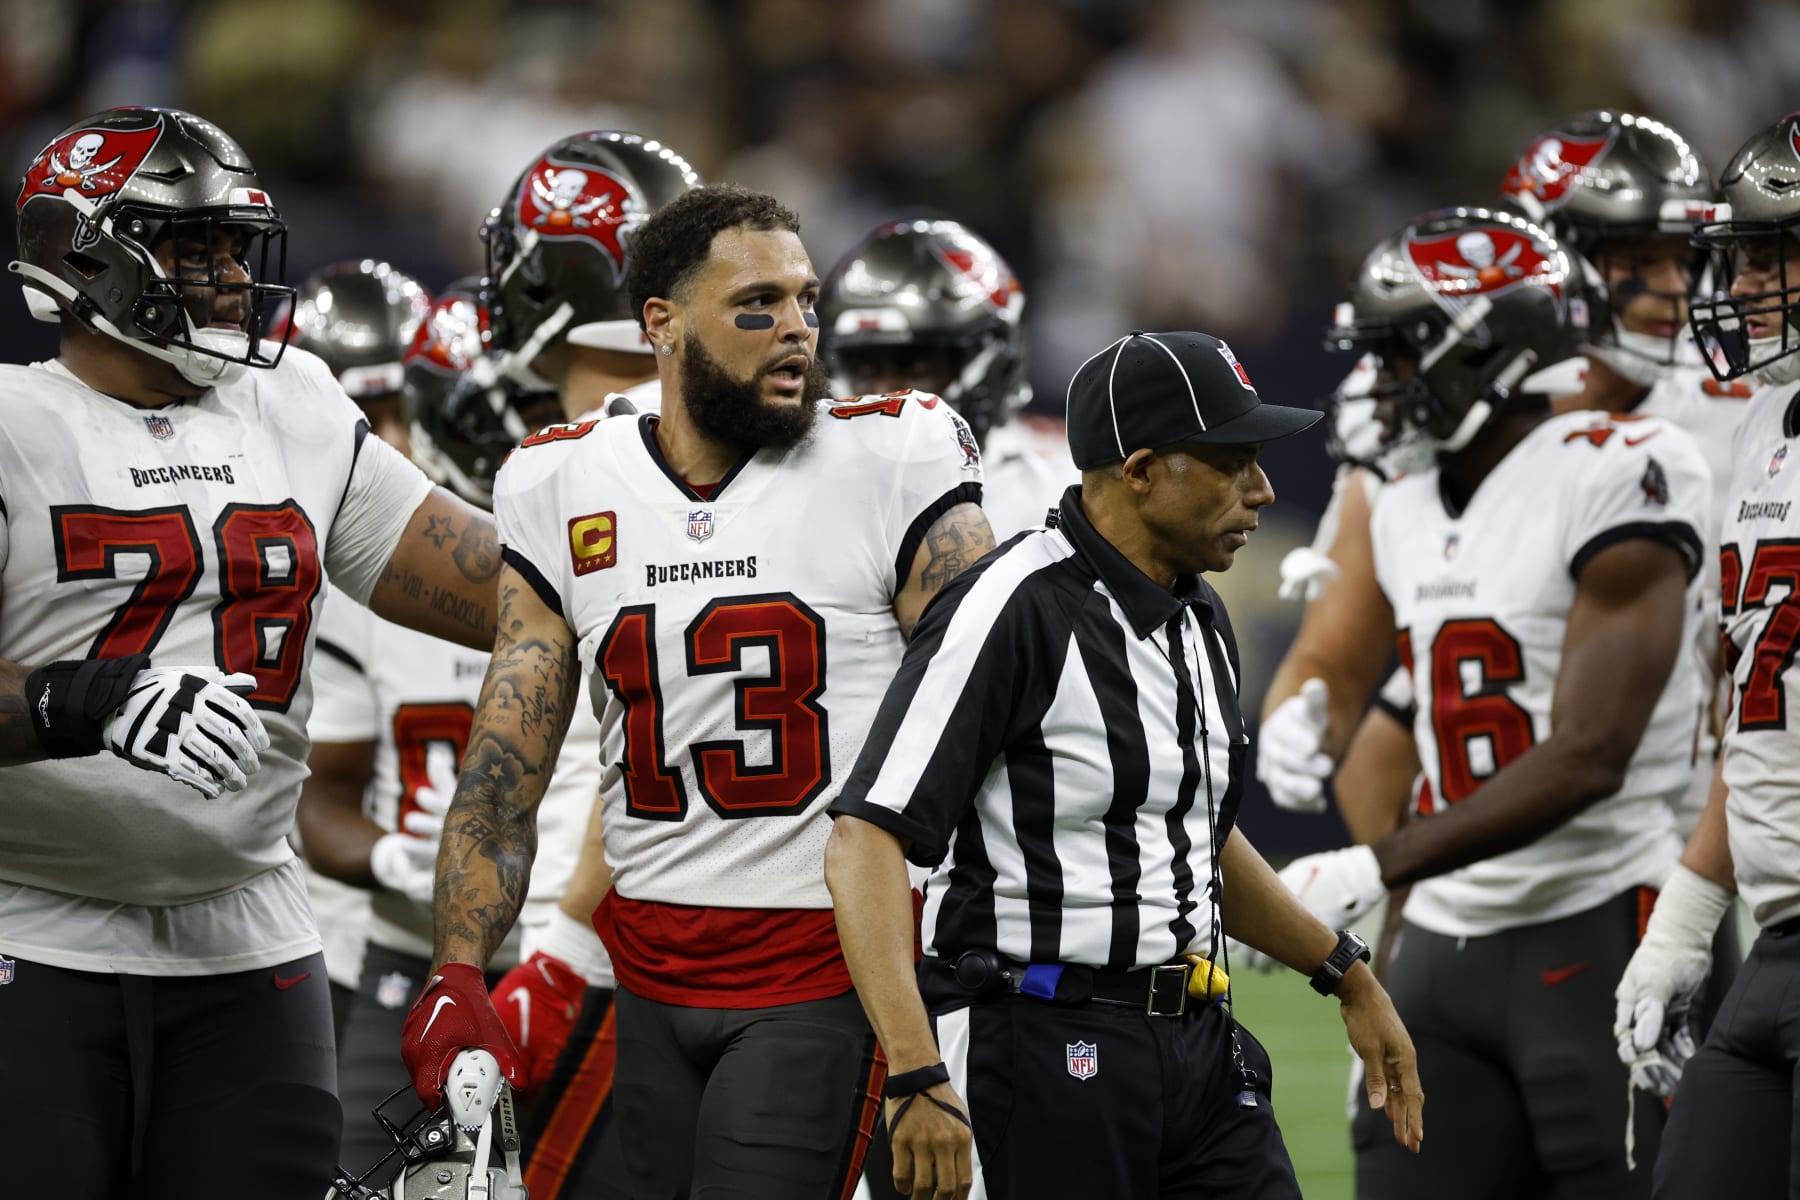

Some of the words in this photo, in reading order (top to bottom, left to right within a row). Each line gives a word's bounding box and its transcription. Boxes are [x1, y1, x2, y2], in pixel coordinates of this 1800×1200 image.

[128, 464, 235, 488] BUCCANEERS
[571, 516, 612, 560] C
[690, 521, 710, 537] NFL
[645, 556, 757, 587] BUCCANEERS
[49, 498, 322, 715] 78
[595, 591, 832, 822] 13
[1071, 1058, 1094, 1075] NFL
